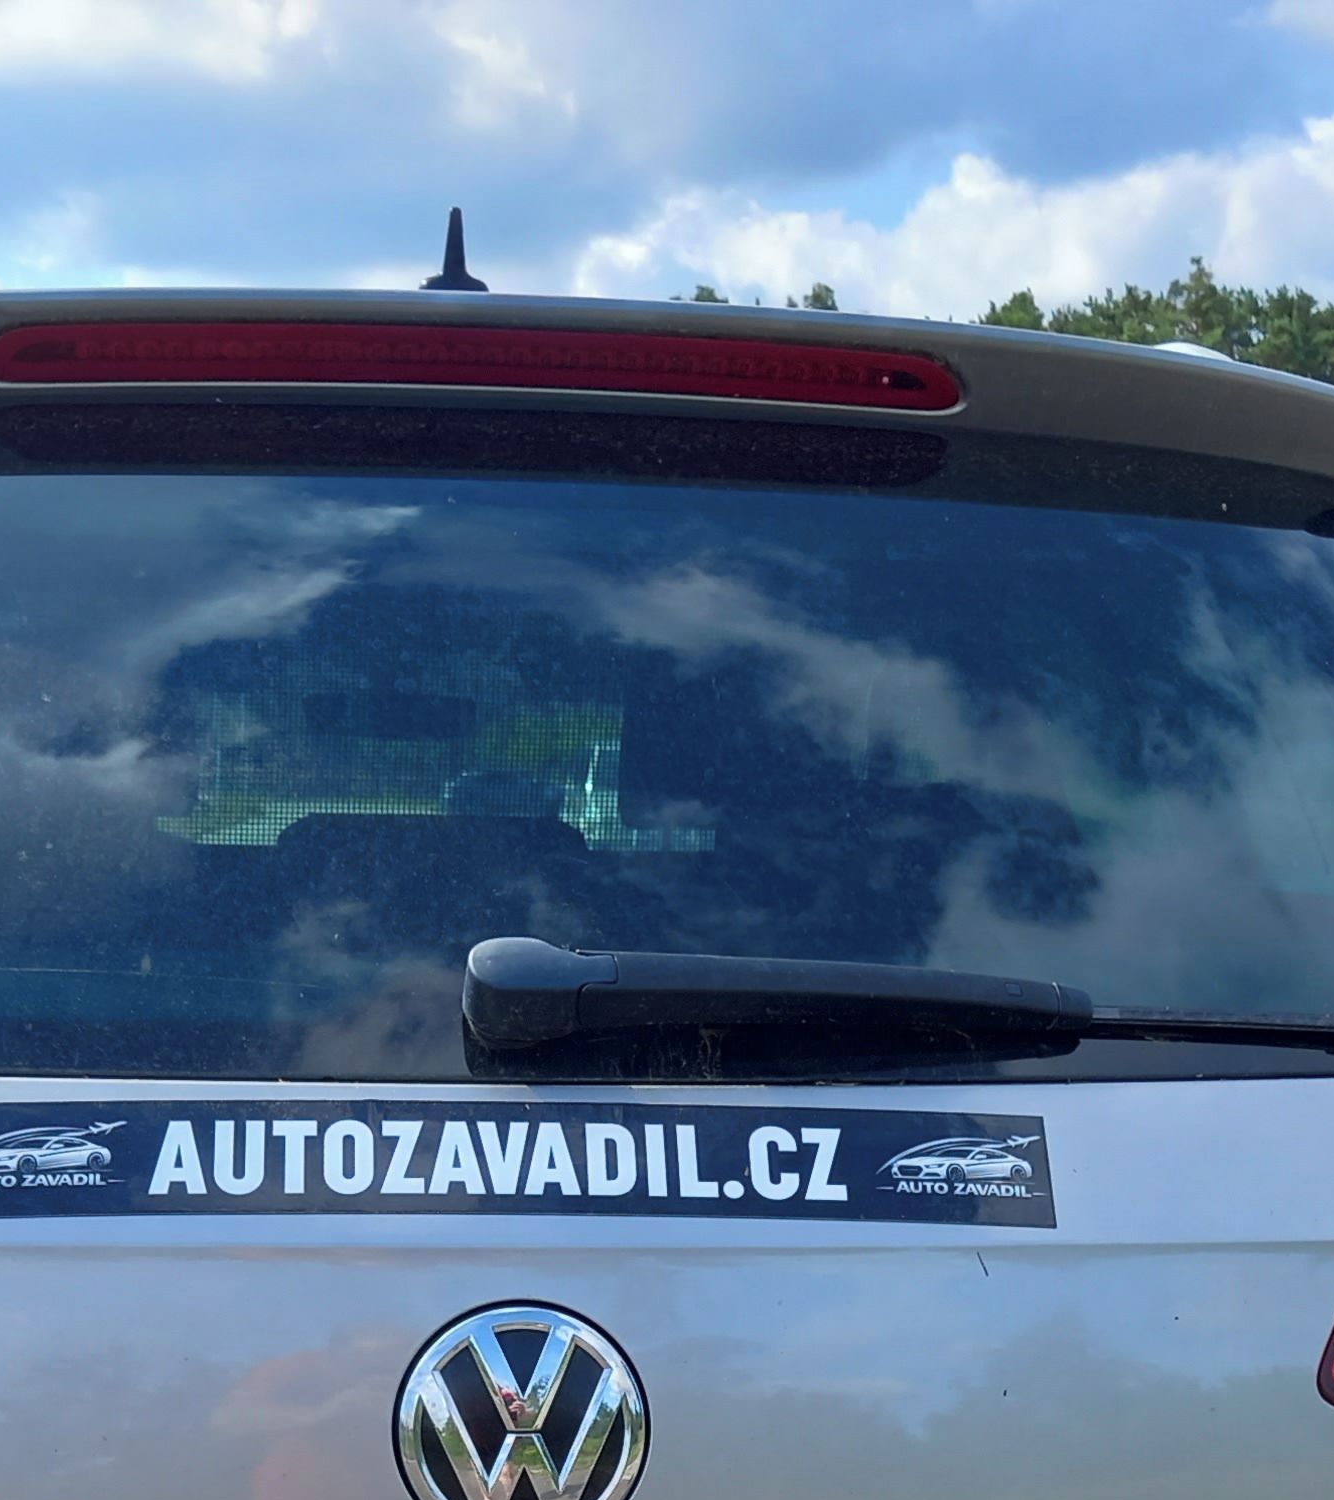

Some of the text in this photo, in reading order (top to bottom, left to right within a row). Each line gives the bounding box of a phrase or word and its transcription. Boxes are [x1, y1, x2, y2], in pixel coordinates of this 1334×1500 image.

[147, 1118, 848, 1201] AUTOZAVADIL.CZ
[20, 1173, 108, 1188] ZAVADIL
[895, 1181, 1033, 1198] AUTO ZAVADIL
